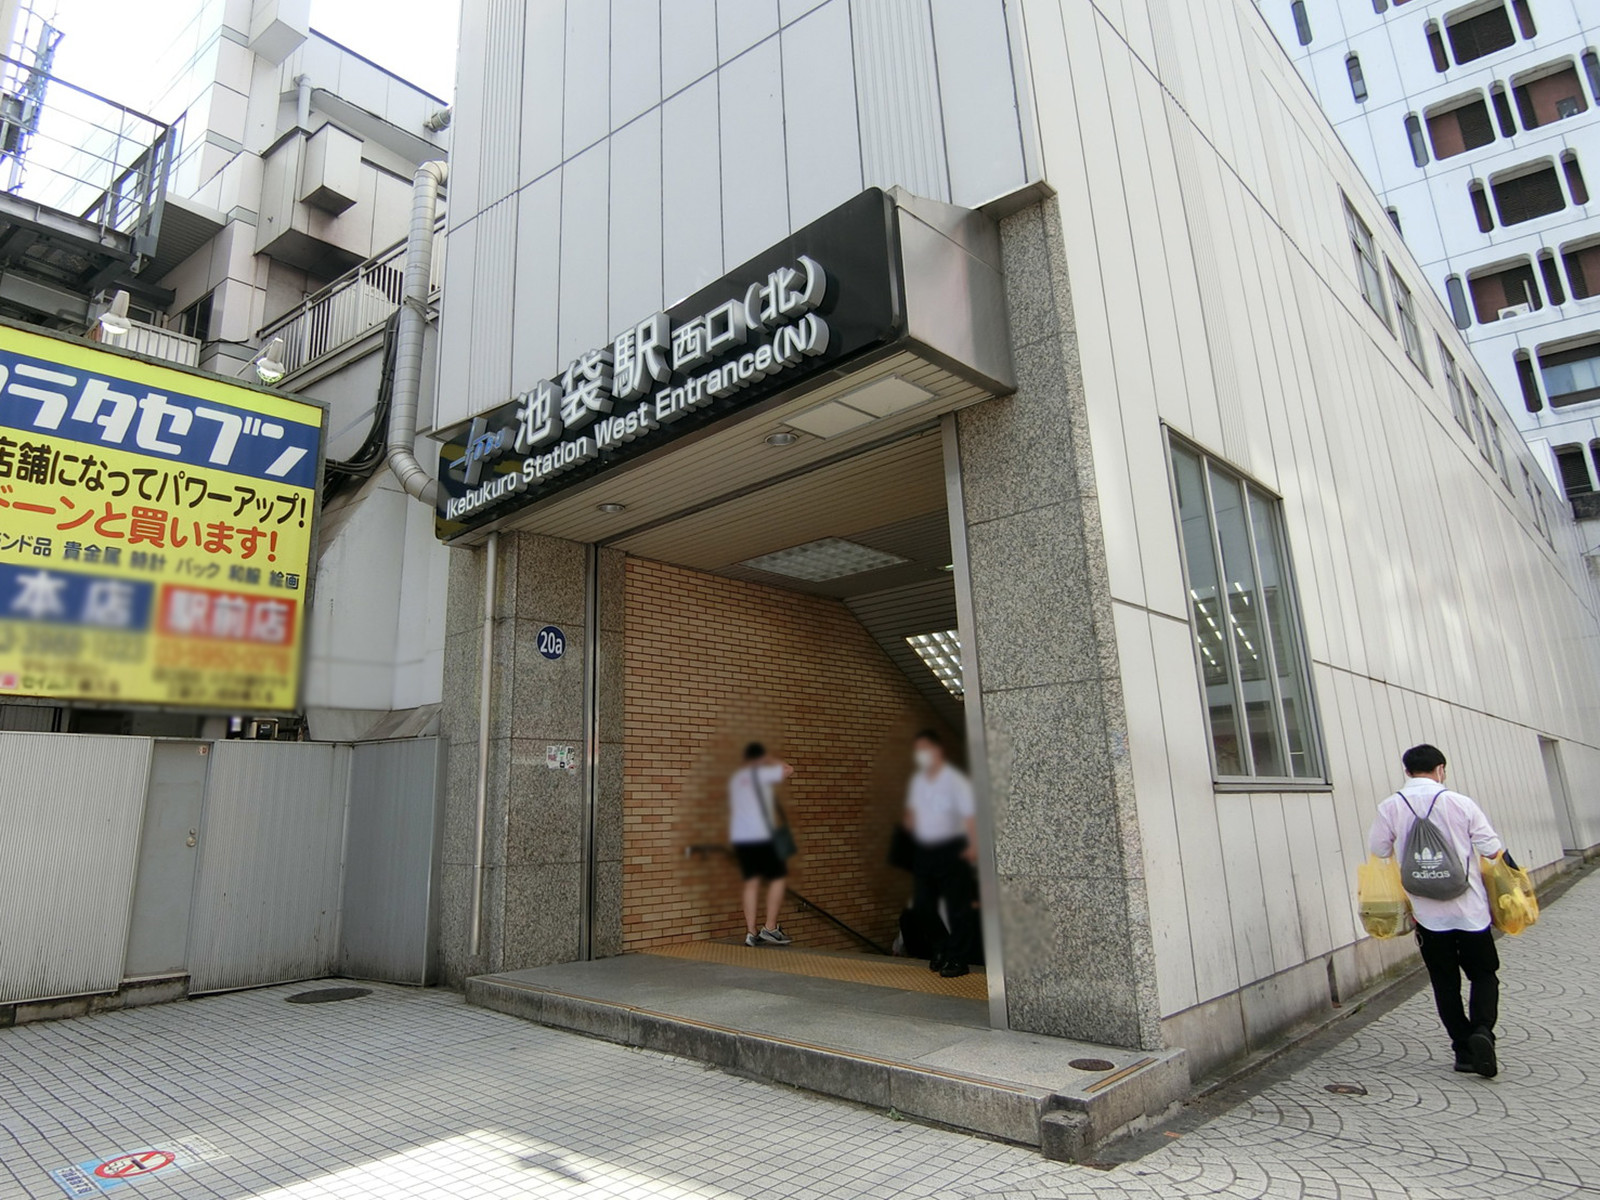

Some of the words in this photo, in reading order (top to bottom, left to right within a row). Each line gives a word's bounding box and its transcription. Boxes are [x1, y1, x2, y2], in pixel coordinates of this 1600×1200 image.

[0, 363, 308, 477] ラタセブン
[446, 471, 518, 521] Ikebukuro
[521, 435, 594, 484] Station
[594, 403, 655, 450] West
[0, 531, 53, 558] ンド品
[540, 631, 563, 655] 20a
[1411, 869, 1451, 879] adidas
